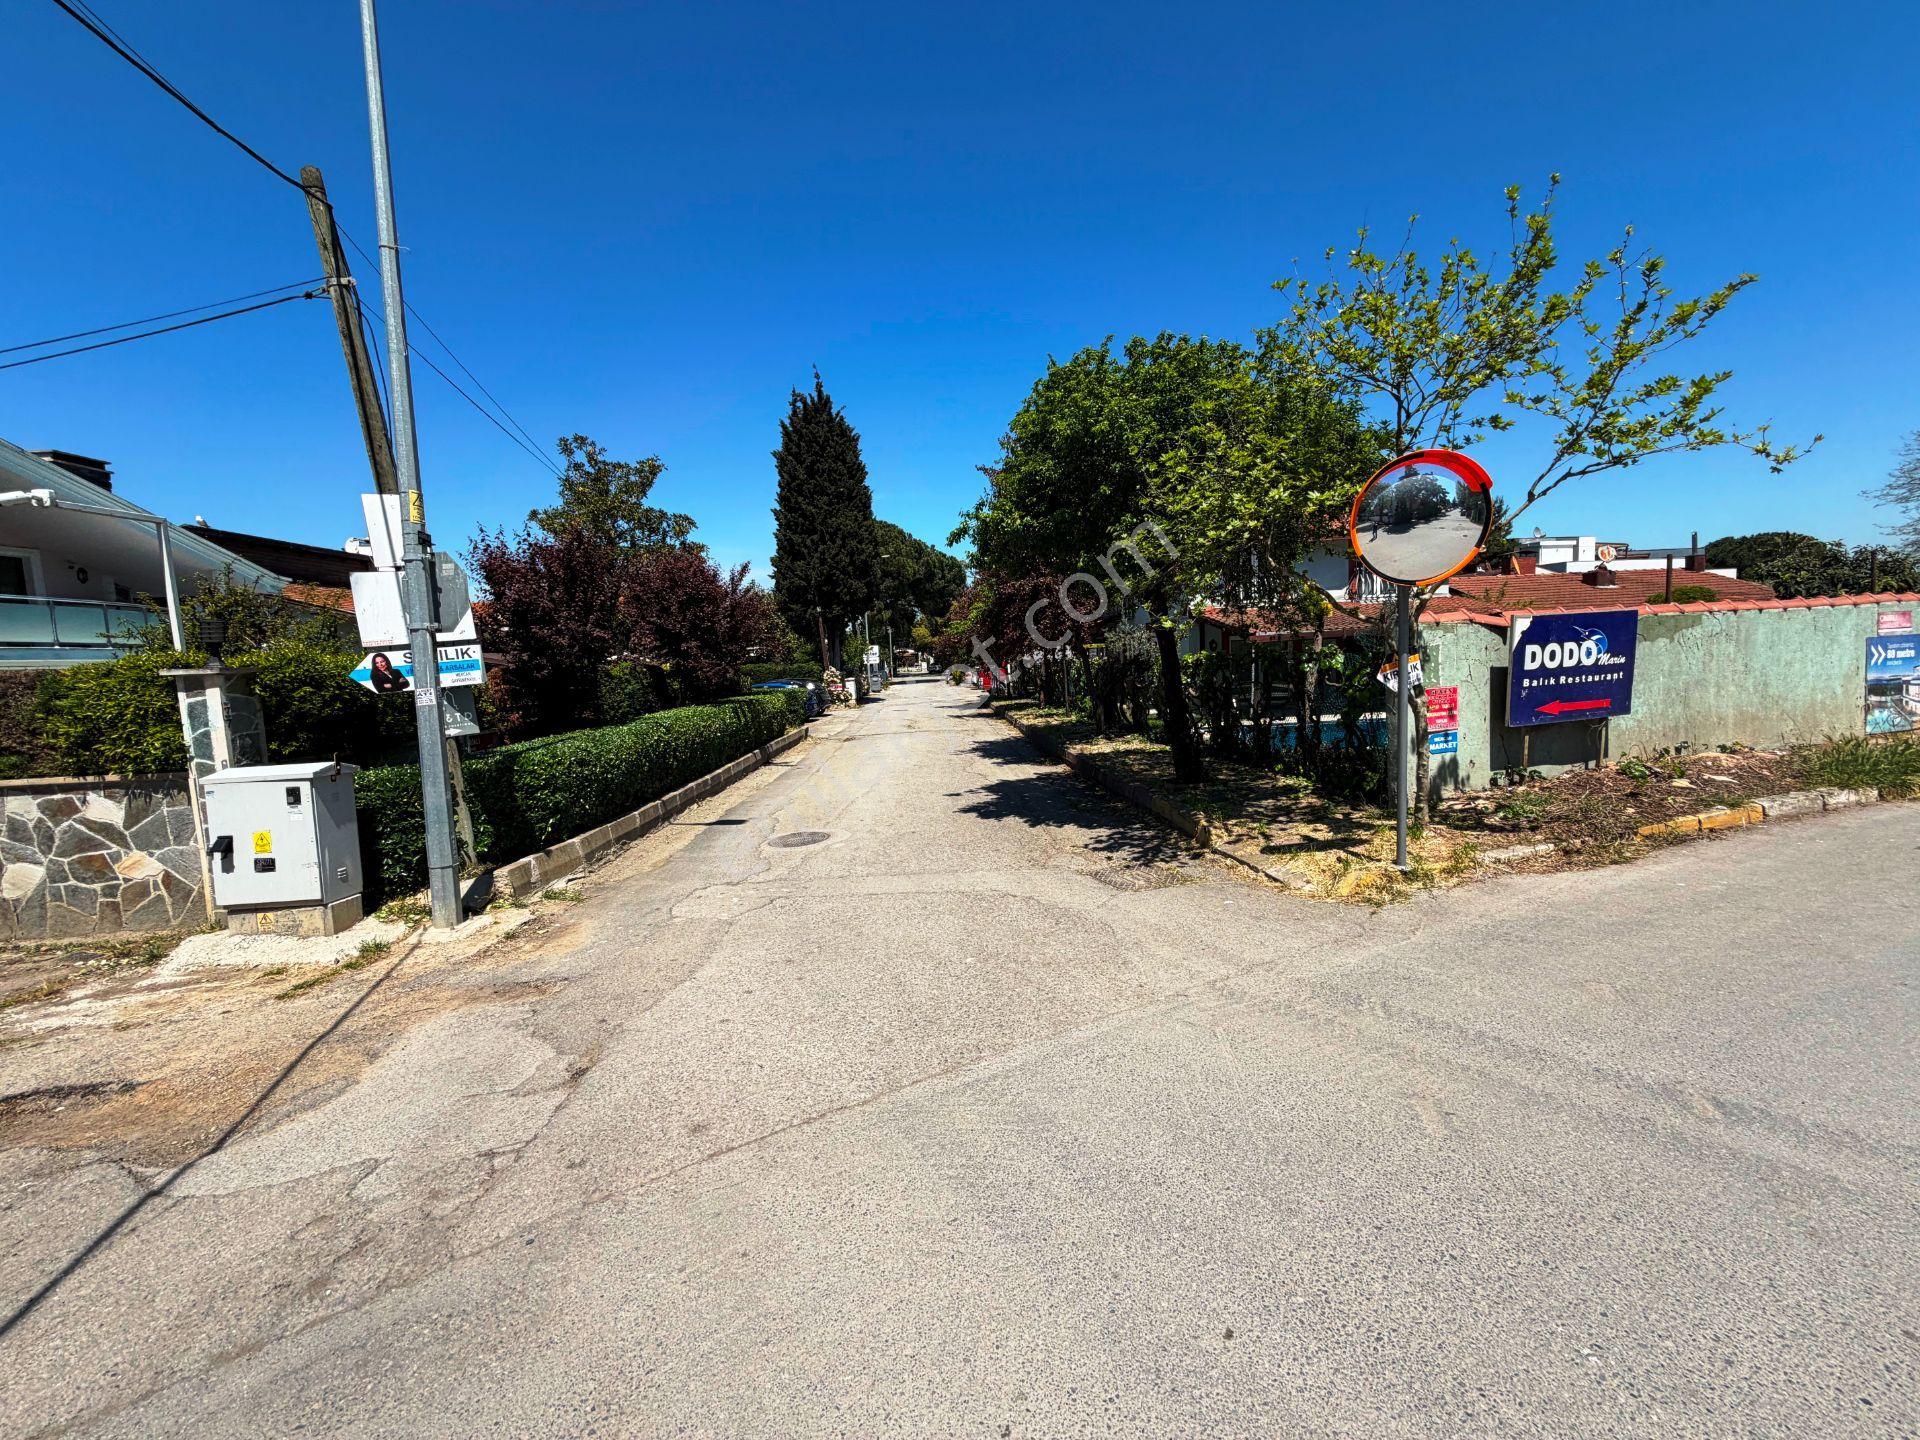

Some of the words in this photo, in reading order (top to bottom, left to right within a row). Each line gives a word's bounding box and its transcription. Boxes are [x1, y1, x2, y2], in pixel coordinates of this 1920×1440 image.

[1524, 640, 1597, 670] DODO
[1597, 652, 1626, 666] Marin
[1523, 677, 1555, 687] Balık
[1560, 671, 1624, 684] Restaurant
[1430, 741, 1457, 750] MARKET
